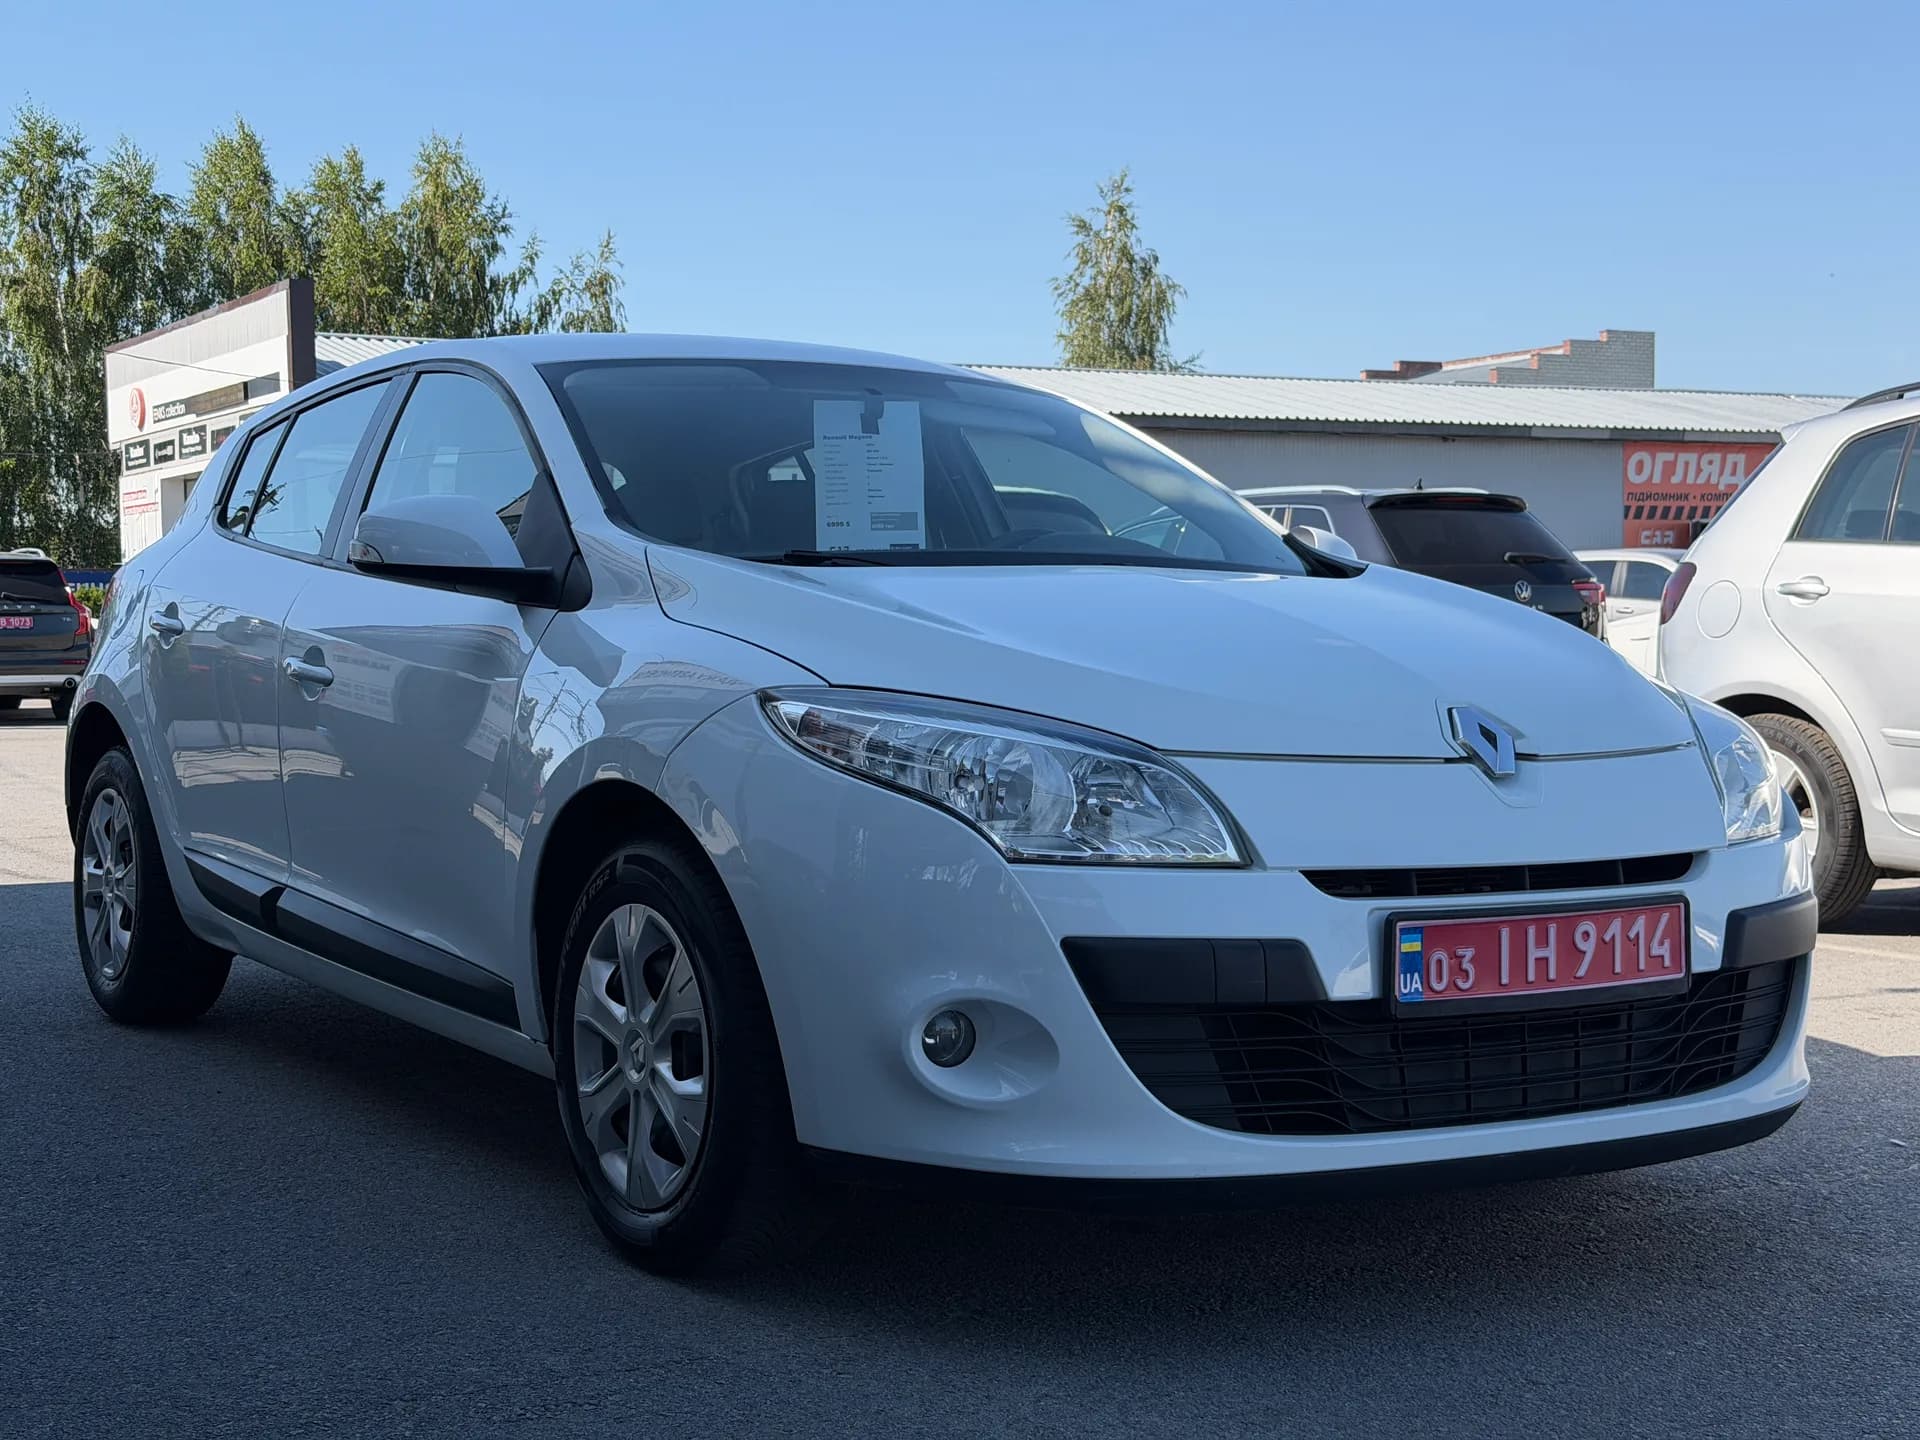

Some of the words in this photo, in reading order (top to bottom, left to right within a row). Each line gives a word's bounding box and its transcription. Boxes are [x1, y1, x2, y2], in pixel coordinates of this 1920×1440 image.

[1627, 451, 1746, 490] ОГЛЯД
[9, 616, 31, 627] 1073
[1428, 949, 1476, 993] 03
[1499, 923, 1558, 986] IH
[1572, 912, 1672, 979] 9114
[1400, 972, 1423, 994] UA
